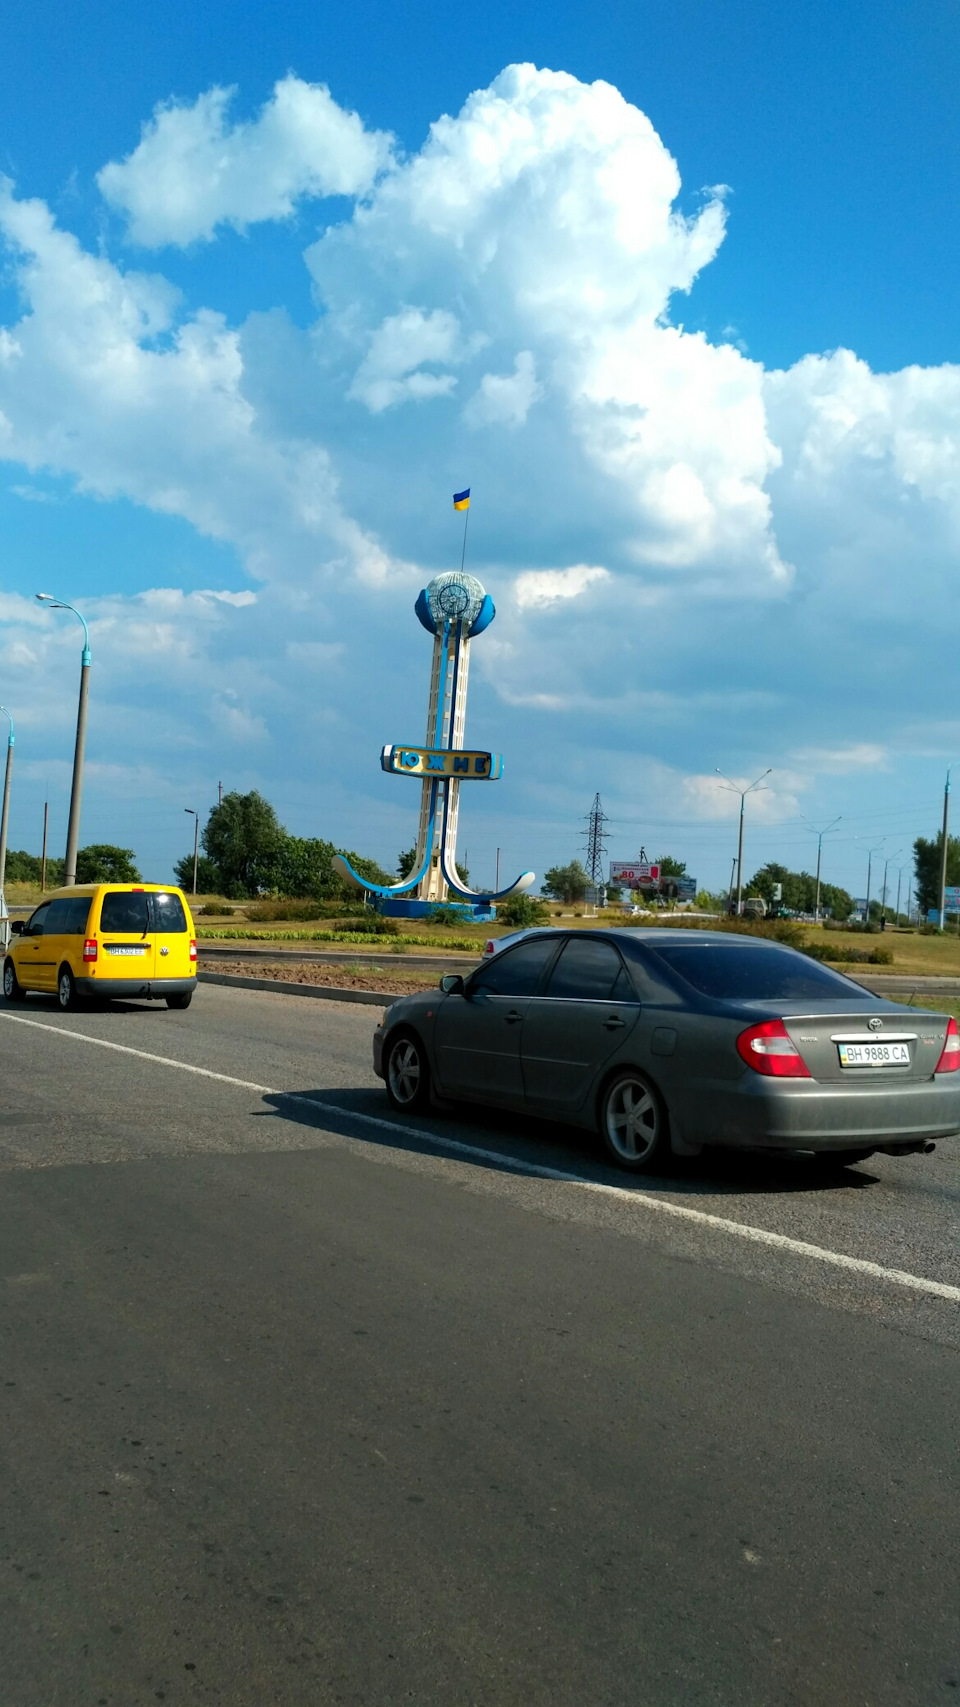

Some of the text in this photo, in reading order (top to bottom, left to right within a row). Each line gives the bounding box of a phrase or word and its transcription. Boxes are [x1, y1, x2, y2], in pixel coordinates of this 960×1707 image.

[400, 751, 486, 772] ЮЖНЕ
[847, 1046, 908, 1060] BH 9888 CA
